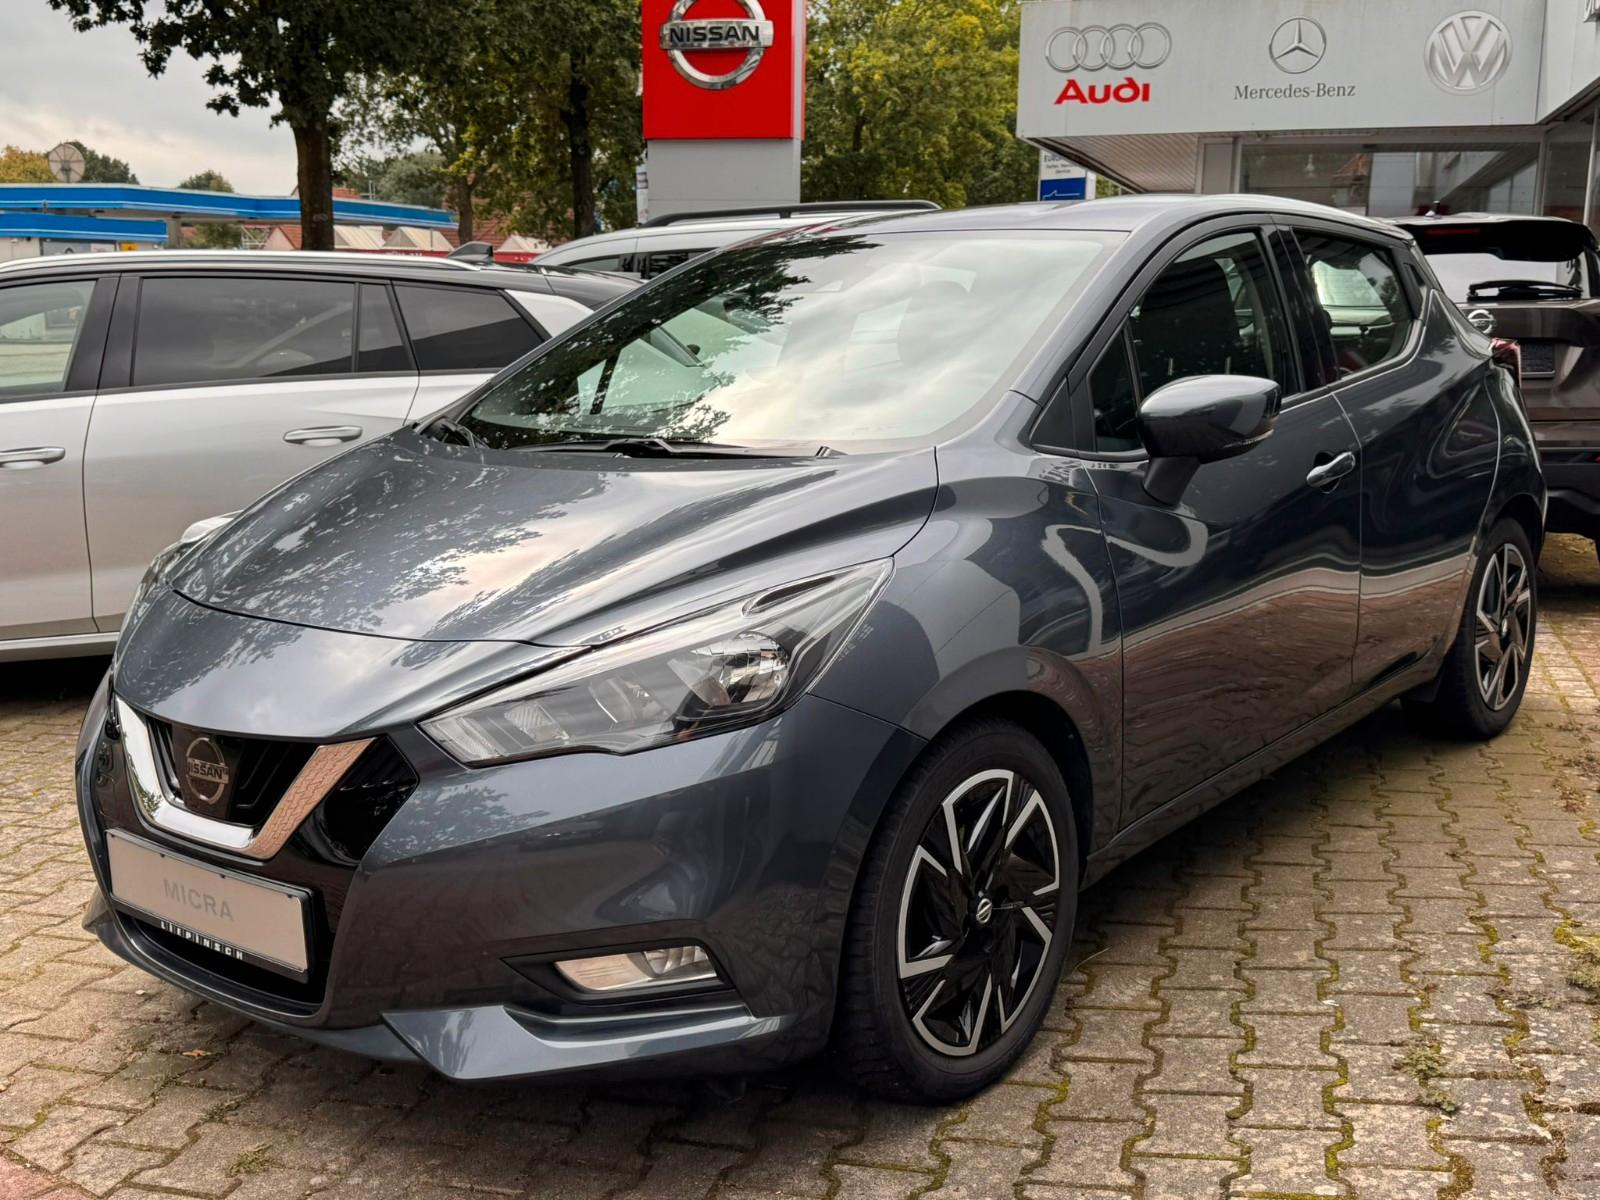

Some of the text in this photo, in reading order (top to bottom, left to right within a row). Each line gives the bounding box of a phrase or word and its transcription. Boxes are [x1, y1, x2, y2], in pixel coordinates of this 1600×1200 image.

[669, 26, 760, 43] NISSAN
[1054, 77, 1150, 105] Audi
[1233, 82, 1356, 100] Mercedes-Benz
[162, 877, 235, 922] MICRA
